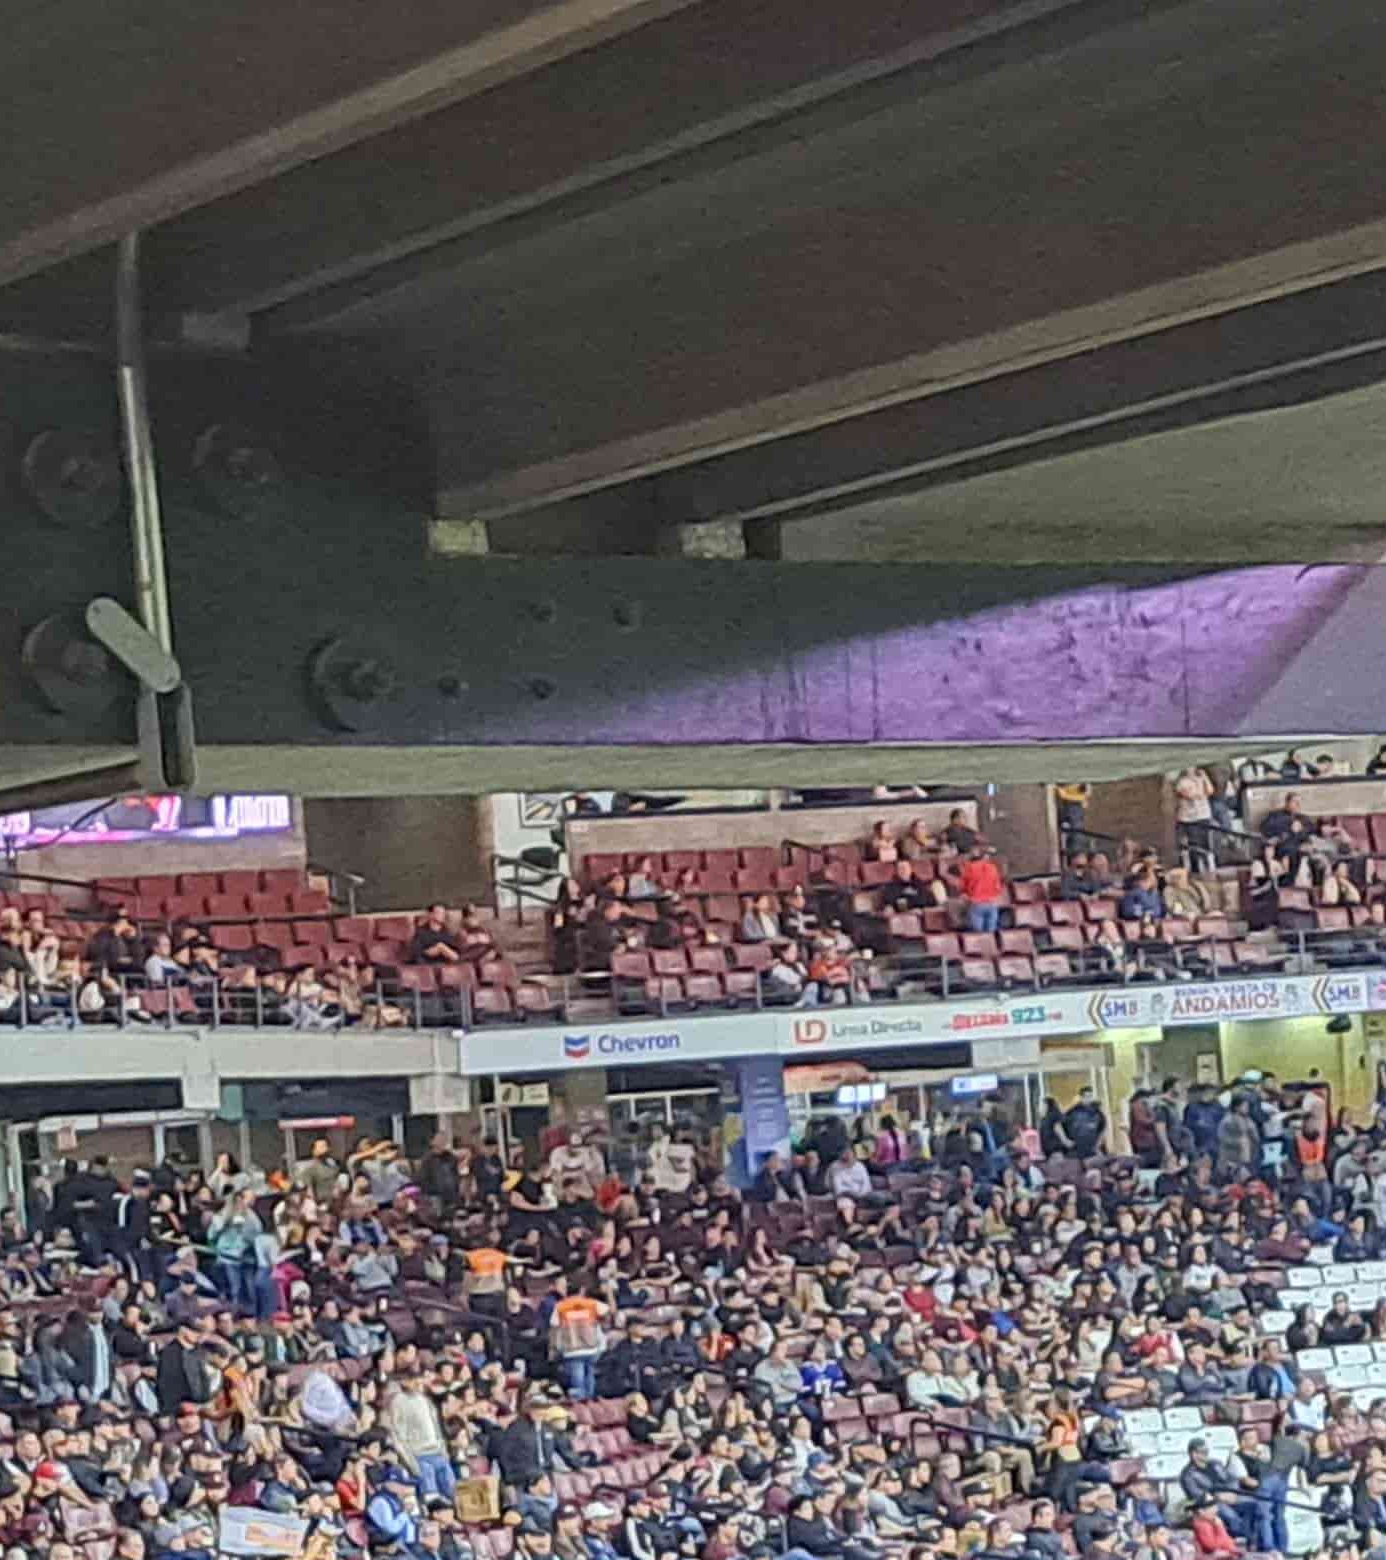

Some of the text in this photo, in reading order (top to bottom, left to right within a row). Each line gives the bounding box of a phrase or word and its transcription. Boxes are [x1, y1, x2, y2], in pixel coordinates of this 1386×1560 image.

[1172, 992, 1280, 1014] ANDAMIOS
[1011, 1005, 1046, 1025] 923
[598, 1032, 680, 1053] Chevron
